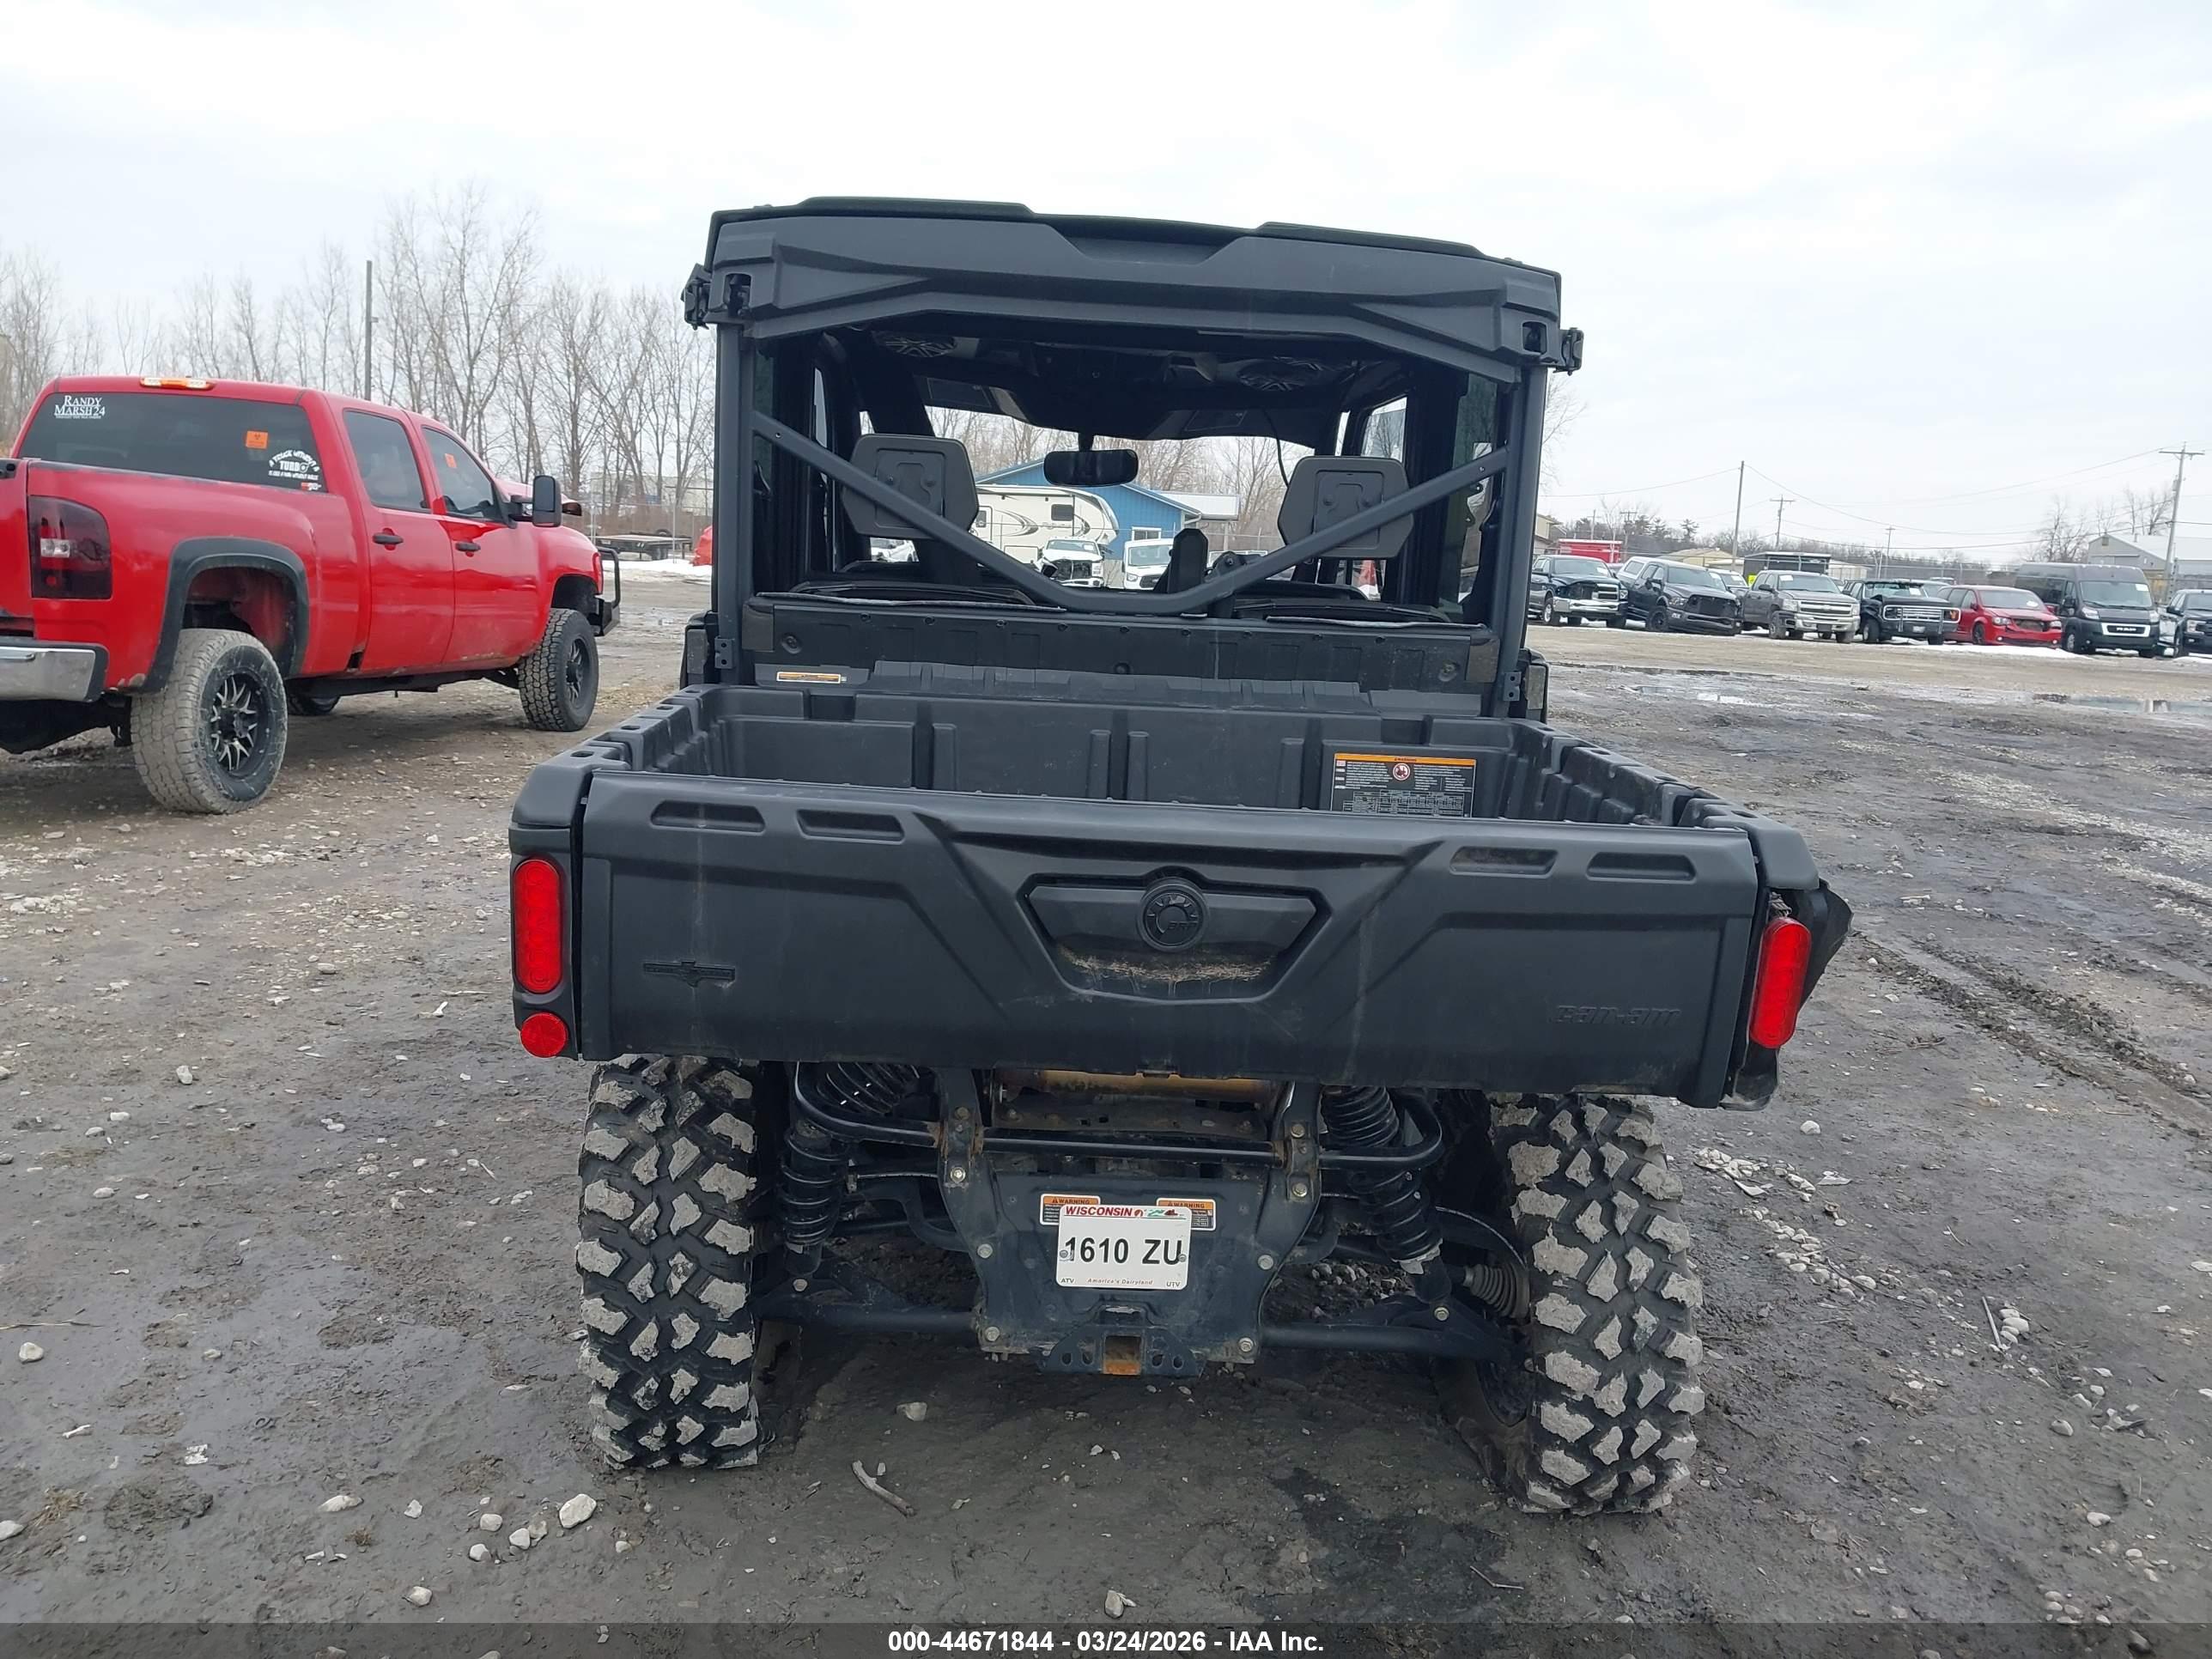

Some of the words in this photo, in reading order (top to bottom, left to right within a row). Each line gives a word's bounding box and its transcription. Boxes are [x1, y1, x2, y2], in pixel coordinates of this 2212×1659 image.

[64, 395, 102, 407] RANDY
[1066, 1206, 1133, 1217] WISCONSIN
[1065, 1237, 1129, 1264] 1610
[1142, 1239, 1182, 1266] ZU
